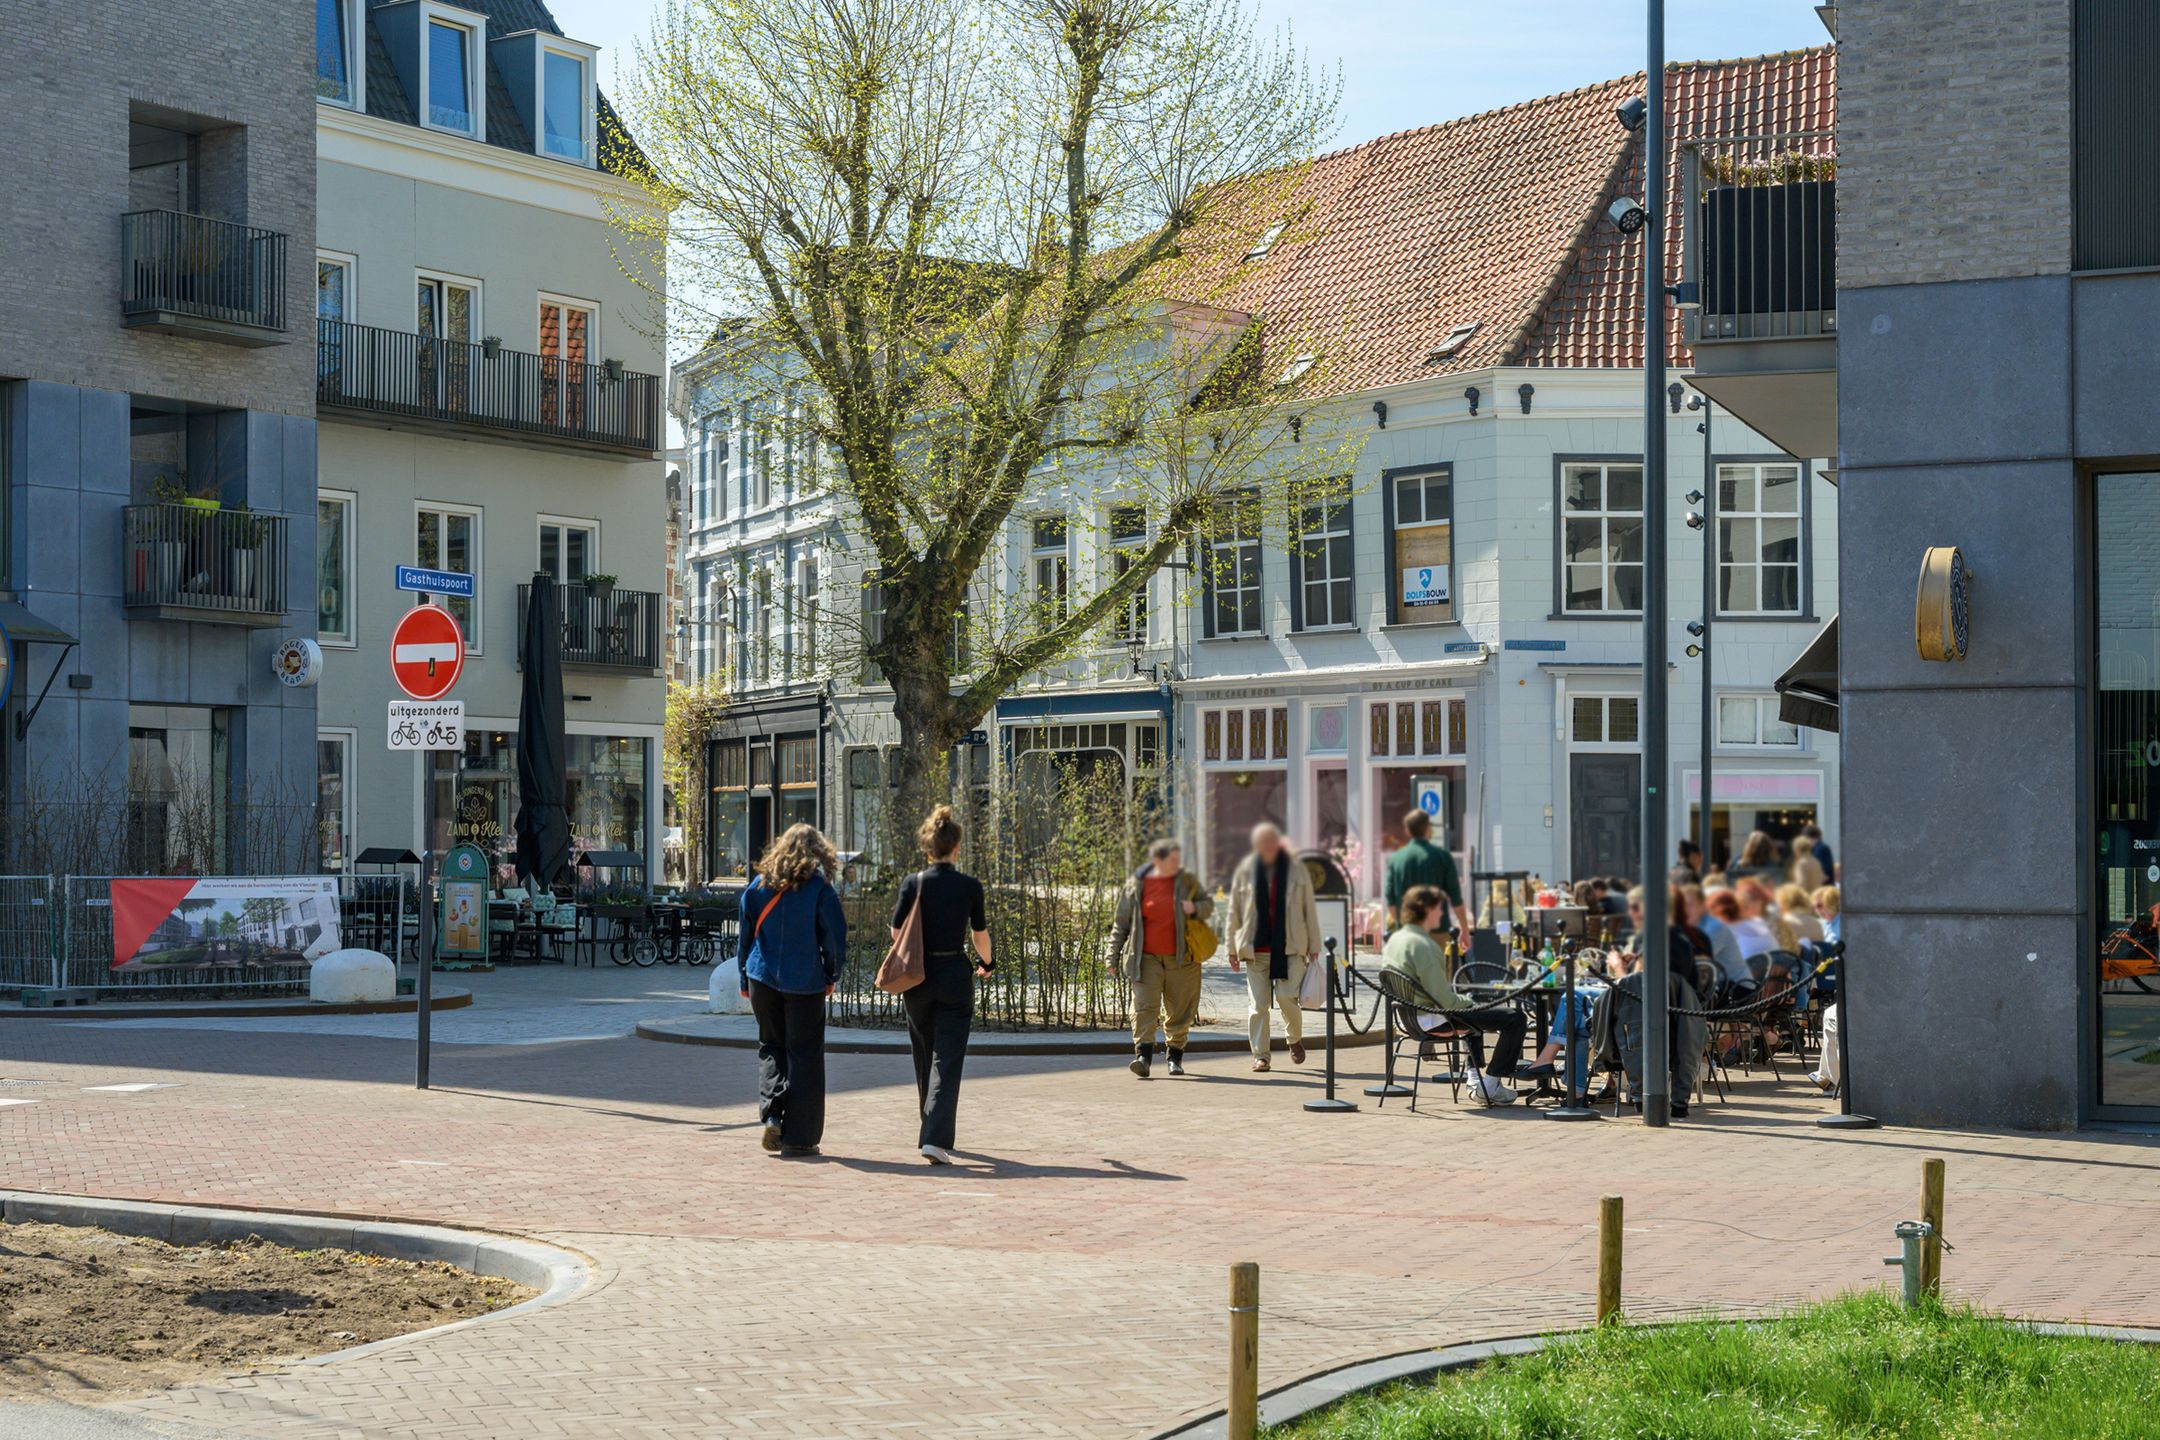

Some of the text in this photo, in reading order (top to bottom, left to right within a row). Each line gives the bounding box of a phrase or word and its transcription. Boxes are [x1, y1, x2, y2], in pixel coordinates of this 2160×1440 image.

[405, 571, 469, 591] Gasthuispoort
[1406, 589, 1447, 599] DOLFSBOUW
[279, 640, 307, 657] BAGELS
[280, 670, 306, 684] BEANS
[1395, 680, 1412, 689] CUP
[1415, 679, 1427, 688] OF
[1429, 678, 1452, 688] CAKE
[1205, 687, 1277, 699] THE CAKE ROOM
[390, 704, 460, 719] uitgezonderd
[447, 821, 470, 837] ZAND
[569, 822, 591, 837] ZAND
